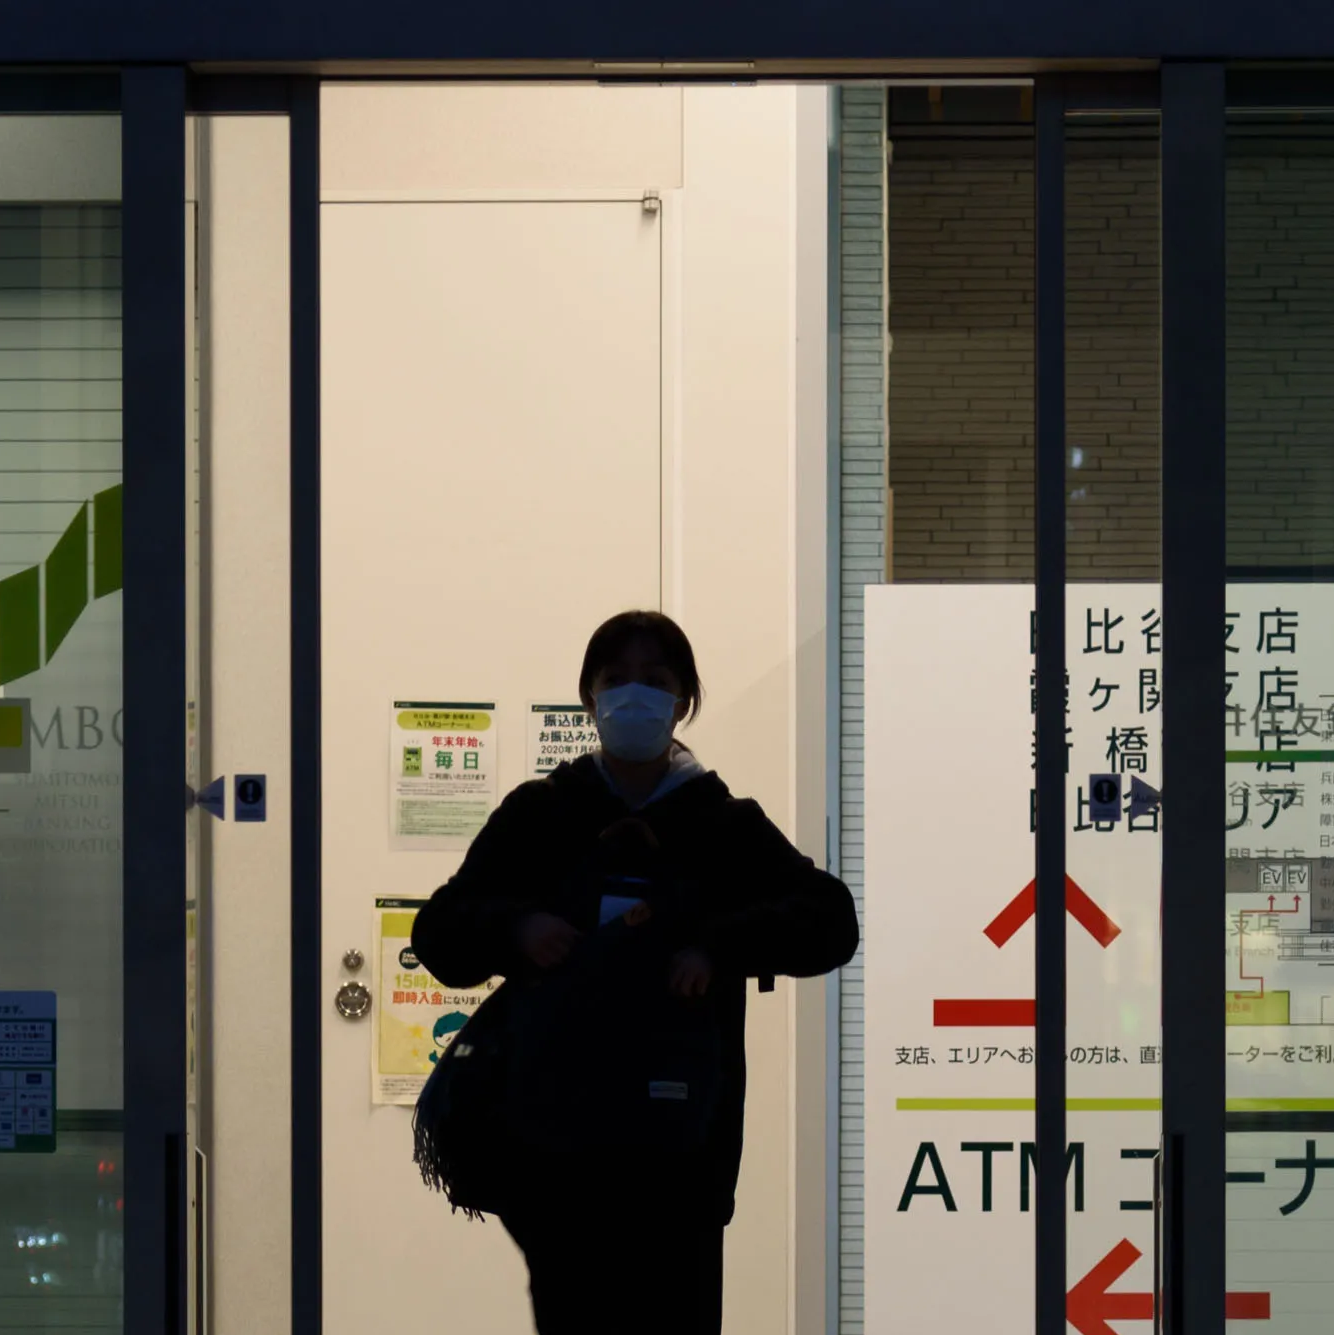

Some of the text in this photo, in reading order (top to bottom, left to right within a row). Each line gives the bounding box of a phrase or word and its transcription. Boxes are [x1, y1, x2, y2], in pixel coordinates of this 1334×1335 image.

[432, 736, 485, 748] 年末年始も
[435, 750, 479, 770] 毎日
[1262, 872, 1306, 884] EV EV
